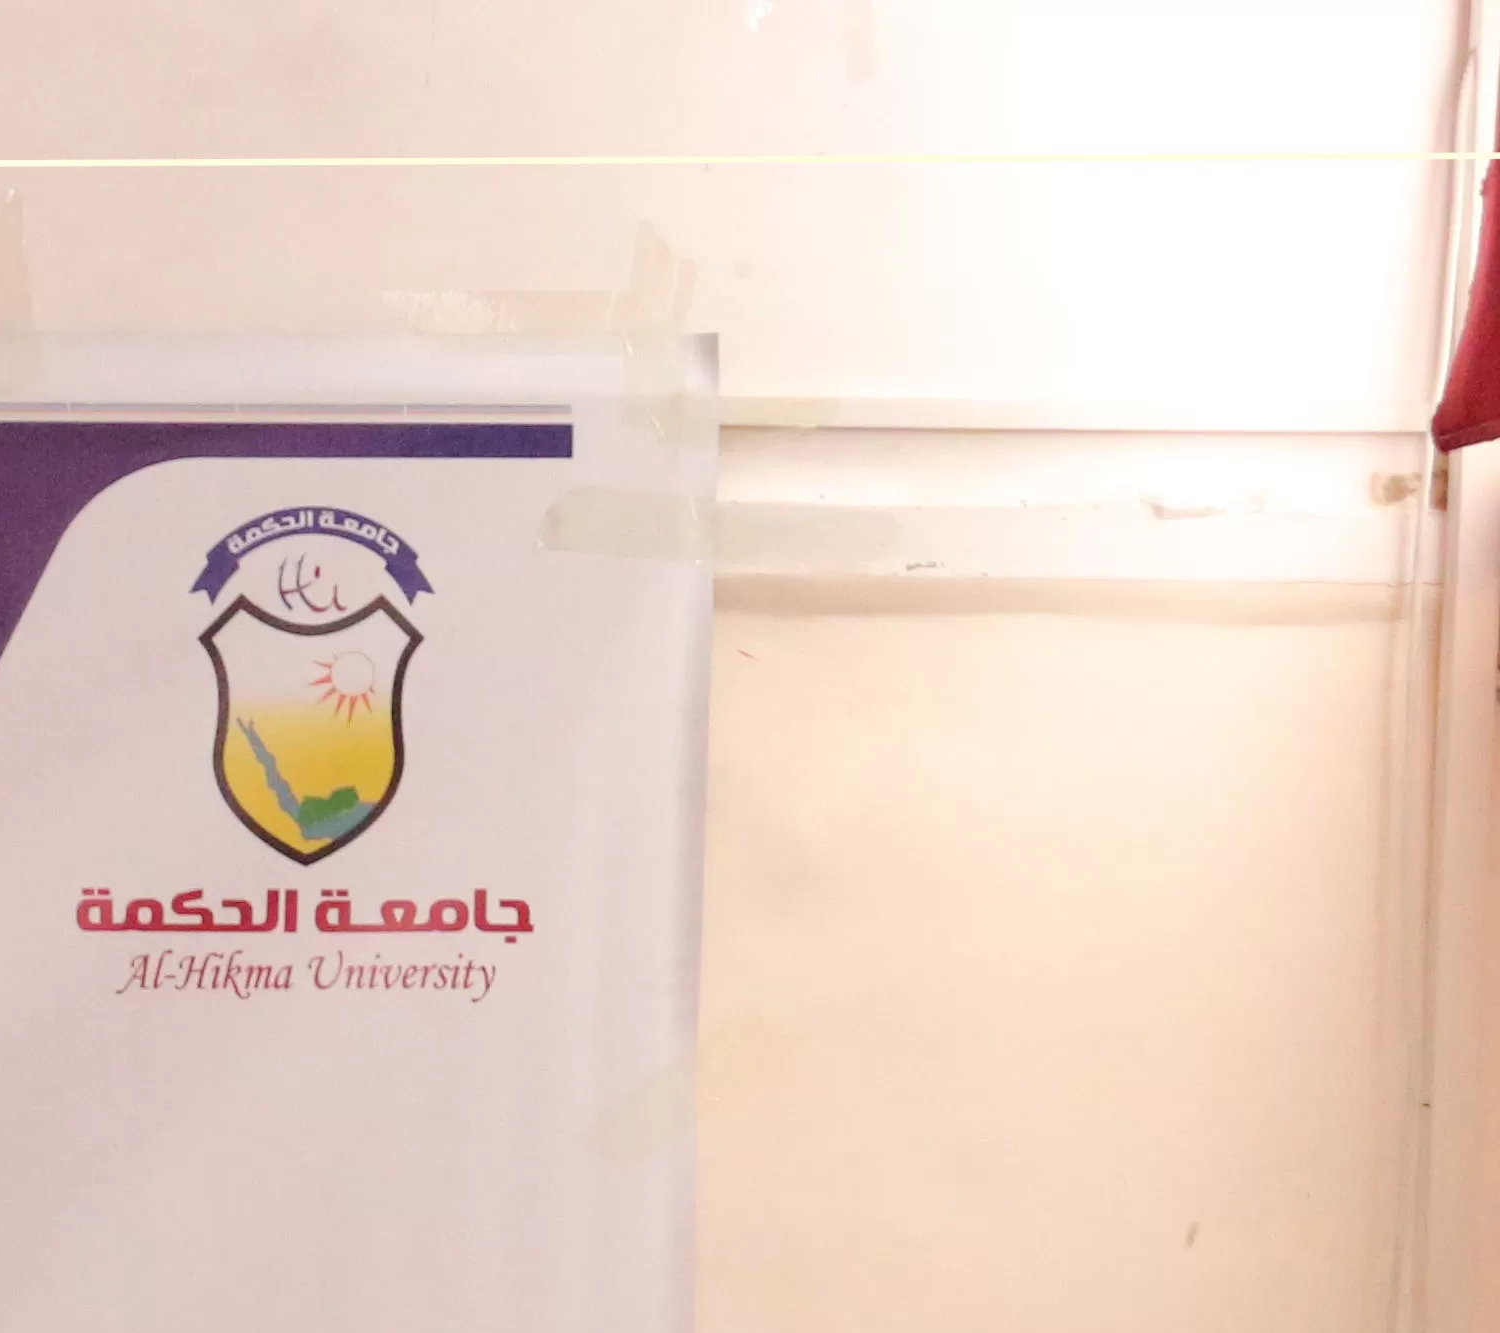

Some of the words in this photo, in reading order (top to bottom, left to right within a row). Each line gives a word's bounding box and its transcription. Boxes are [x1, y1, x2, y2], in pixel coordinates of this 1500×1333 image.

[227, 509, 314, 554] الحكمة
[318, 510, 401, 556] جامعة
[75, 887, 299, 935] الحكمة
[314, 887, 535, 944] جامعة
[115, 947, 293, 1002] Al-Hikma
[306, 948, 497, 1004] University
